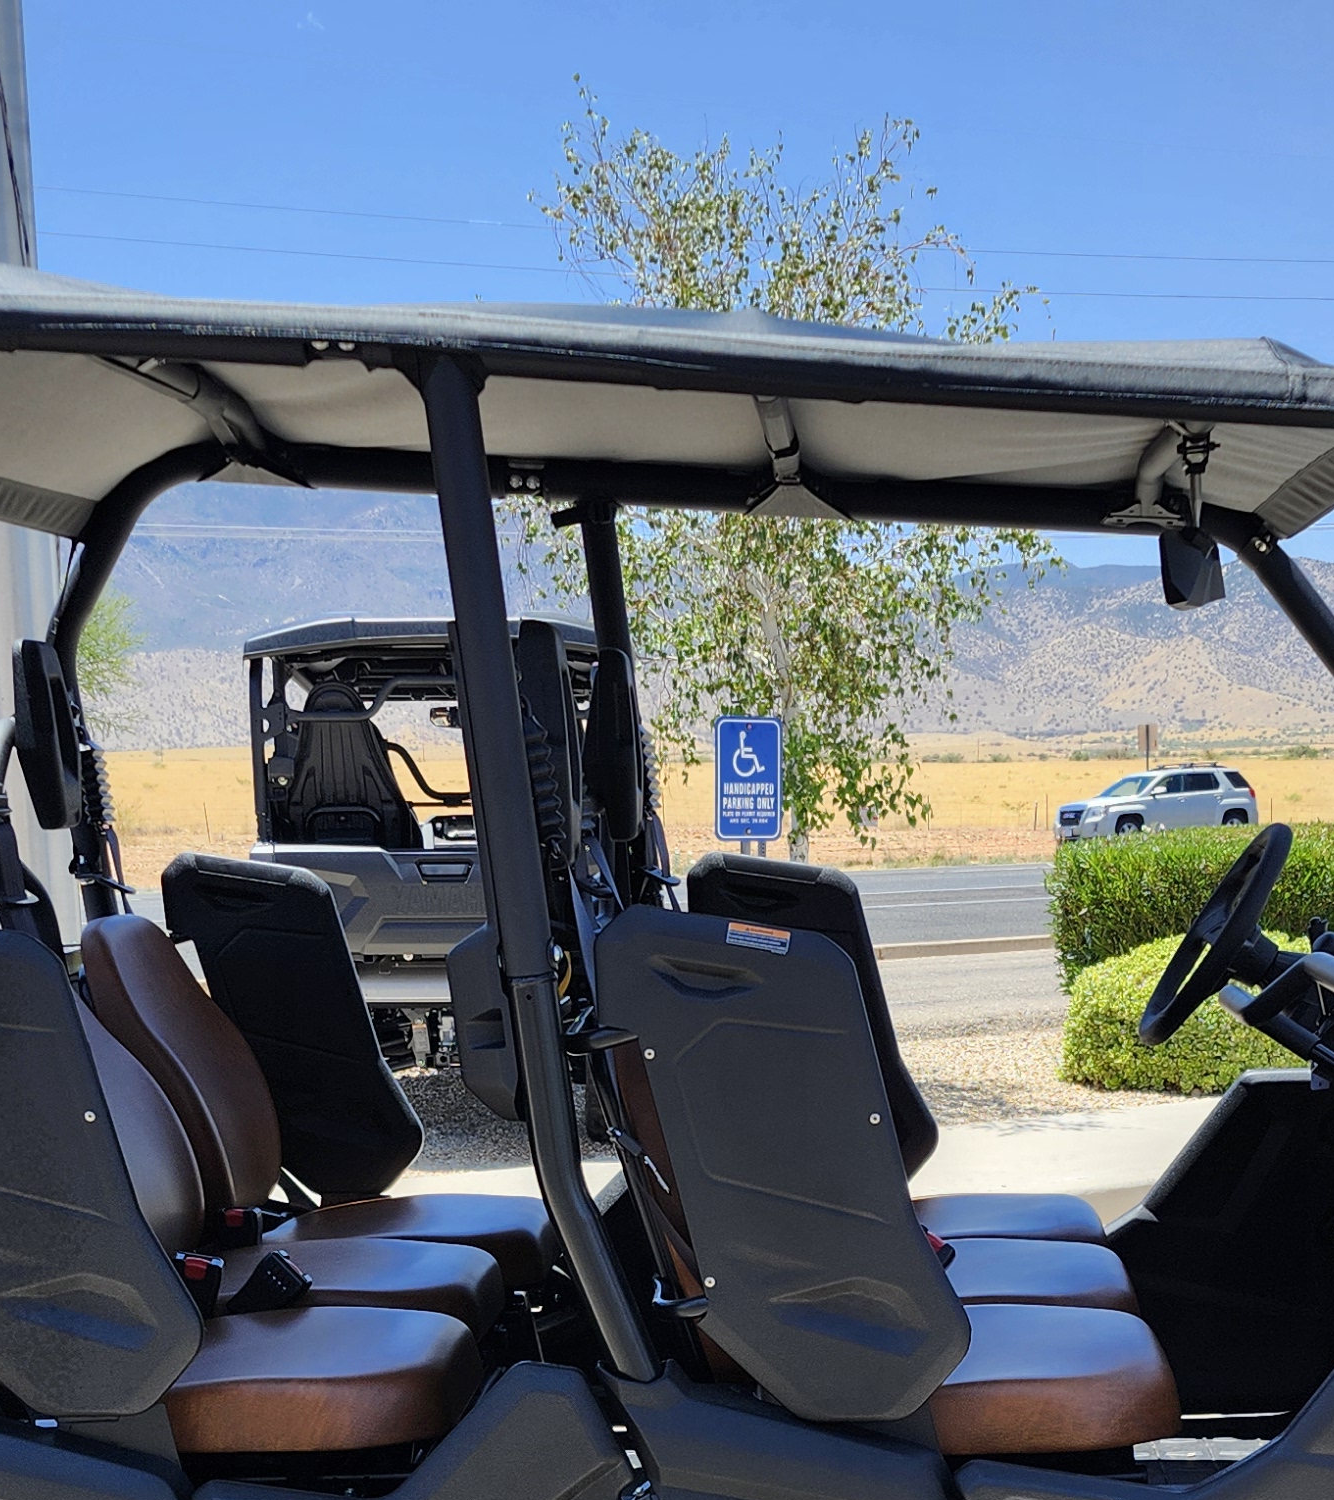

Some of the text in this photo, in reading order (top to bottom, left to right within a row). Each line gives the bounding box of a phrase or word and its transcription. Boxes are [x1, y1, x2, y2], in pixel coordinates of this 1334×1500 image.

[724, 783, 774, 795] HANDICAPPED
[722, 797, 775, 810] PARKING ONLY
[390, 885, 484, 914] YAMAH
